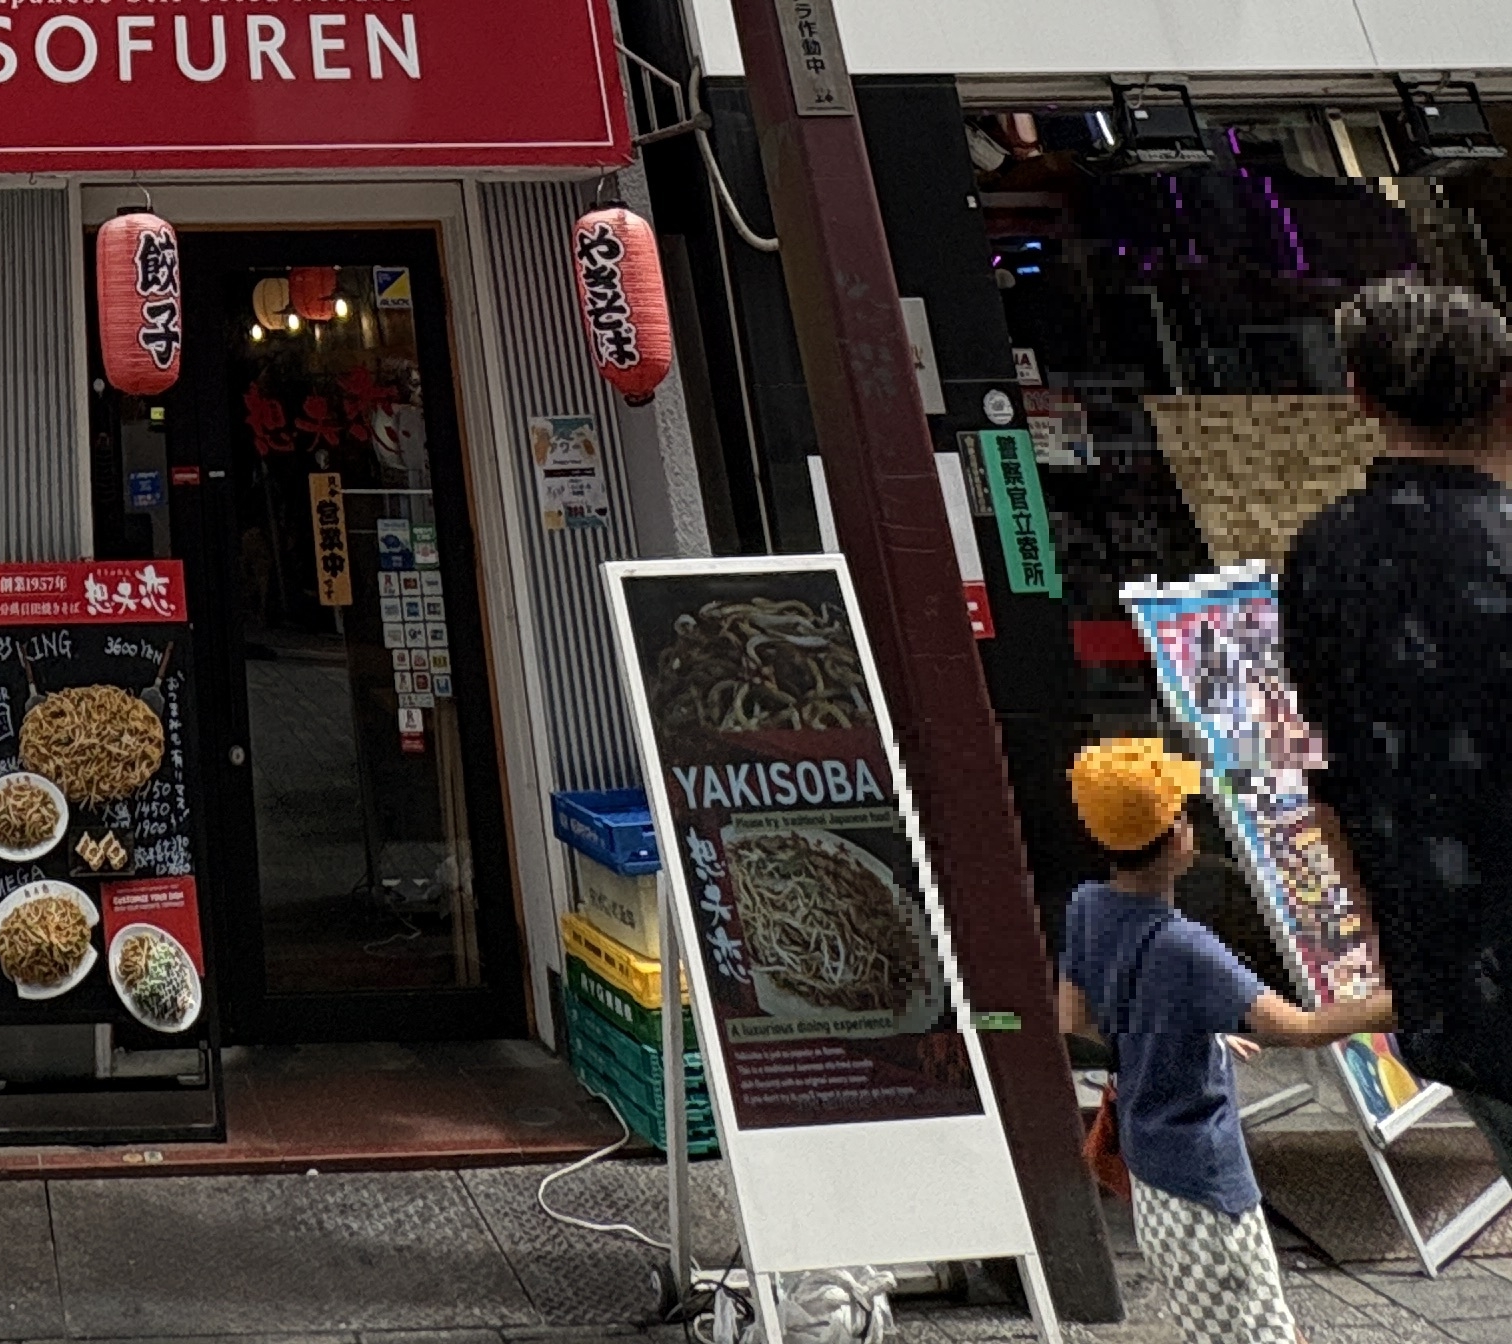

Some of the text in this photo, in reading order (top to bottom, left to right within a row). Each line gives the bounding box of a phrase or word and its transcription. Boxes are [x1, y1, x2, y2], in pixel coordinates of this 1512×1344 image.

[135, 226, 181, 370] 餃子
[576, 223, 640, 370] やきそば
[995, 435, 1045, 589] 警察官立寄所
[15, 628, 73, 669] KING
[103, 635, 139, 658] 3600
[671, 757, 886, 810] YAKISOBA
[731, 1016, 893, 1037] A luxurious dining experience
